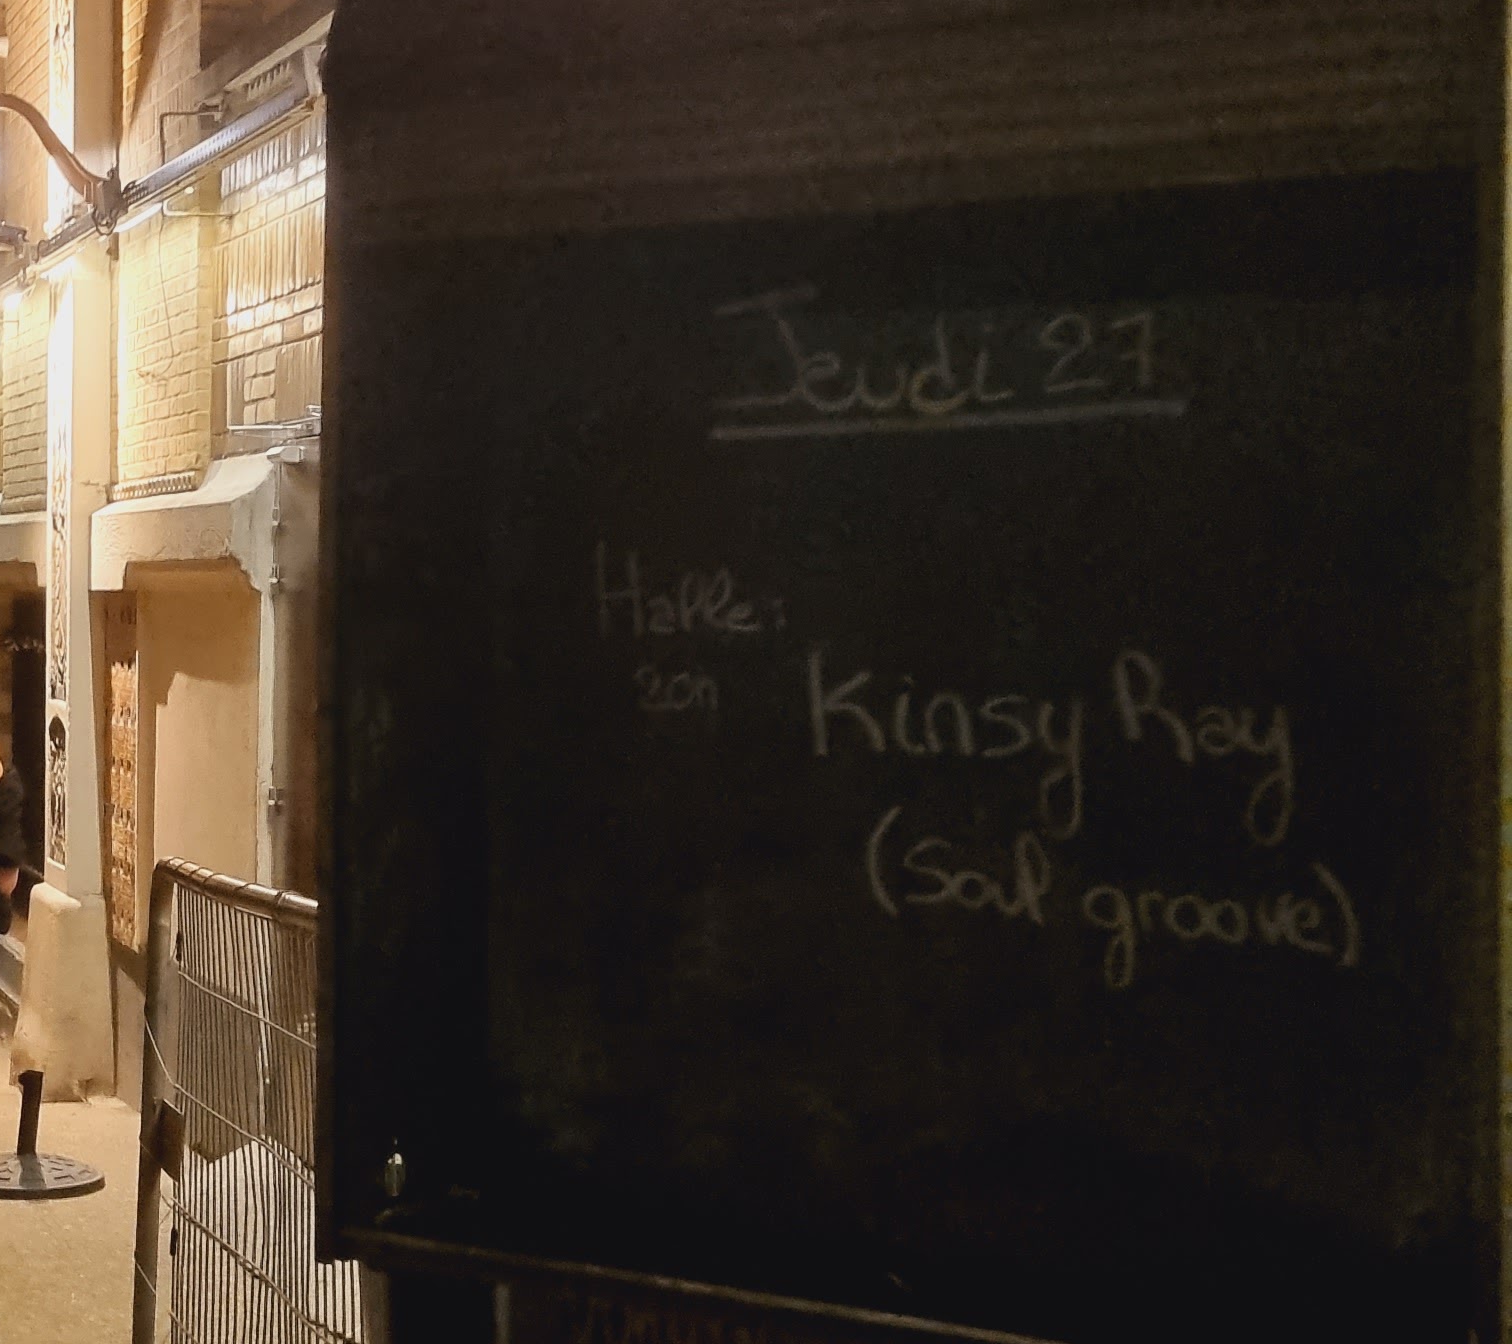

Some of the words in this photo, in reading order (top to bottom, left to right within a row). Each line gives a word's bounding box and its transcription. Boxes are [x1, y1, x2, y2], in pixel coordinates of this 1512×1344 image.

[711, 283, 1015, 416] Jeudi
[806, 651, 1084, 839] Kinsy
[1113, 650, 1290, 845] Ray
[1082, 862, 1360, 989] groove)
